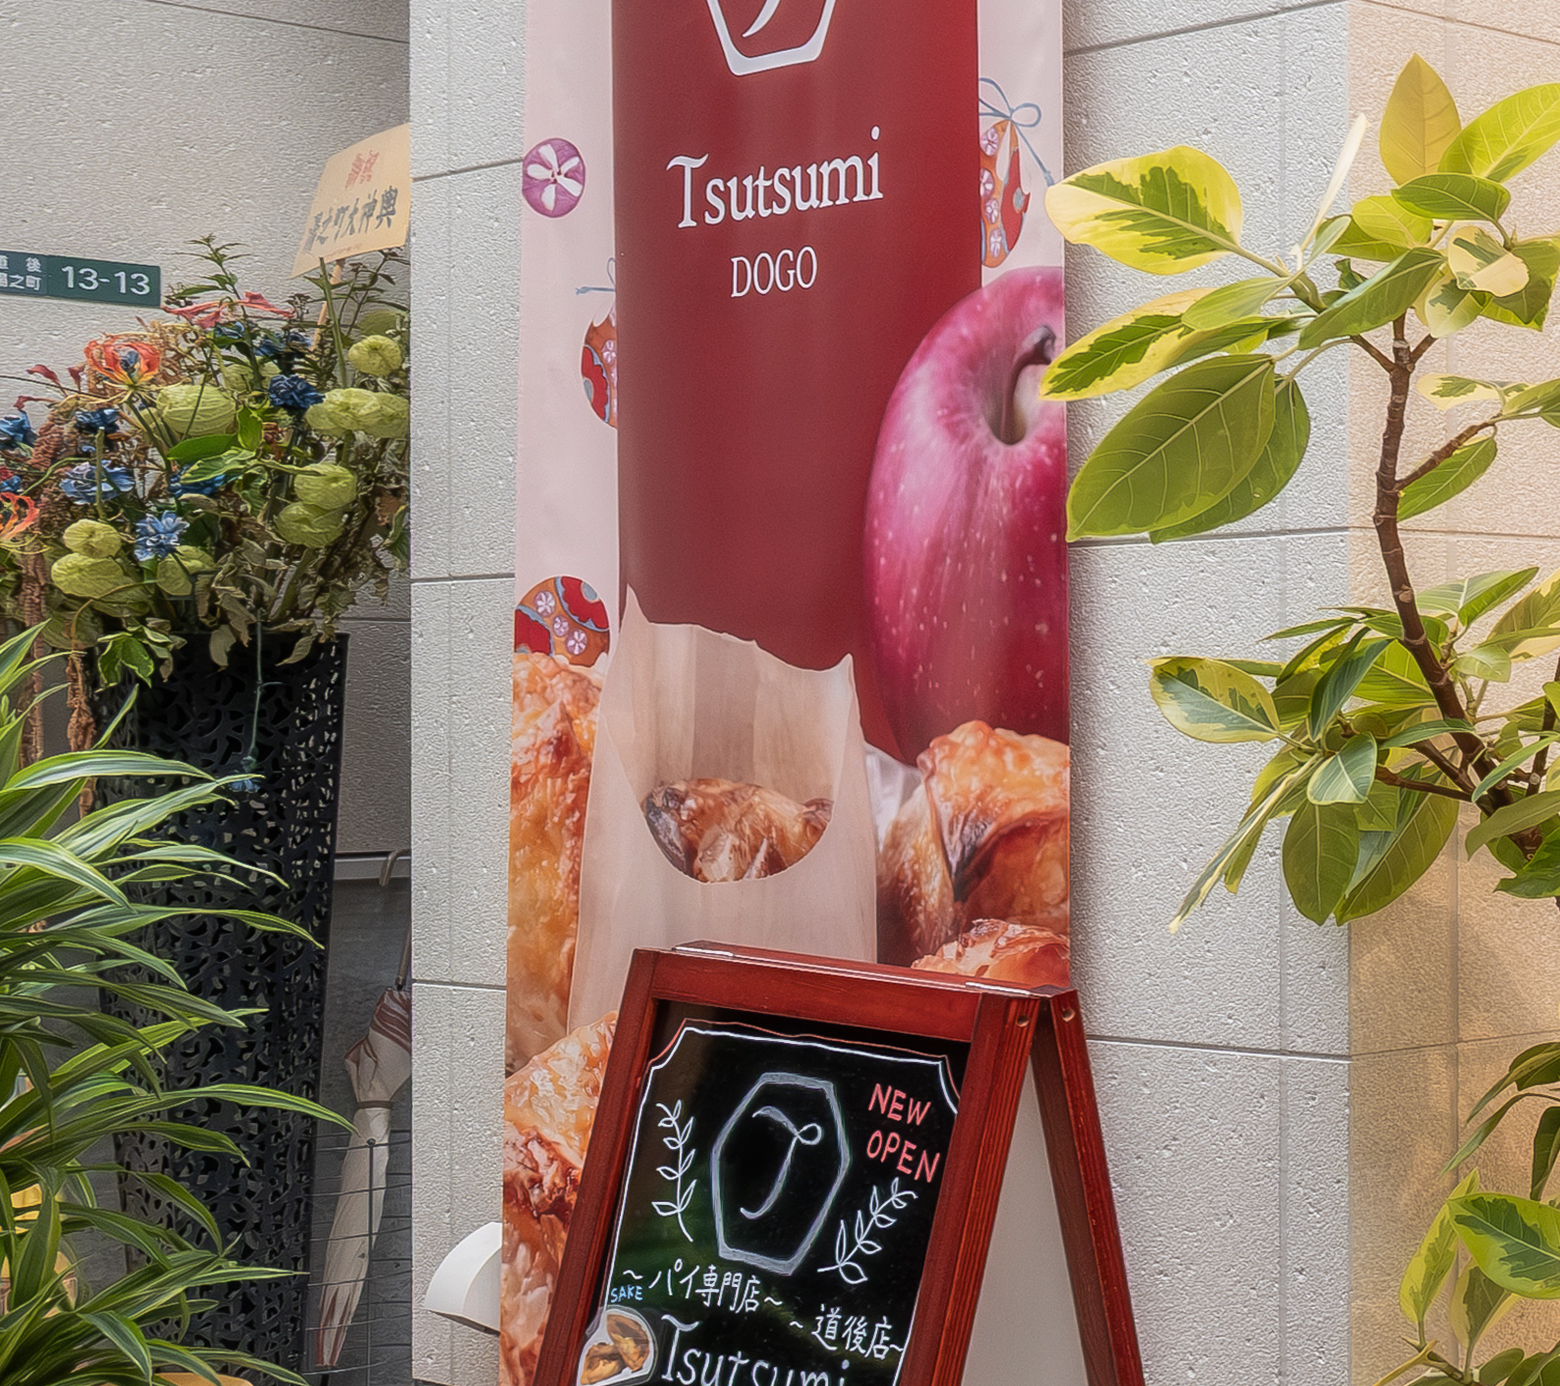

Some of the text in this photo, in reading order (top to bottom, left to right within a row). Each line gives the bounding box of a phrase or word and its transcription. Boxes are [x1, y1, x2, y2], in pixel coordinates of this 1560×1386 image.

[666, 125, 884, 230] Tsutsumi
[61, 265, 150, 295] 13-13
[730, 244, 818, 299] DOGO
[868, 1083, 932, 1126] NEW
[866, 1130, 941, 1183] OPEN
[610, 1284, 644, 1302] SAKE
